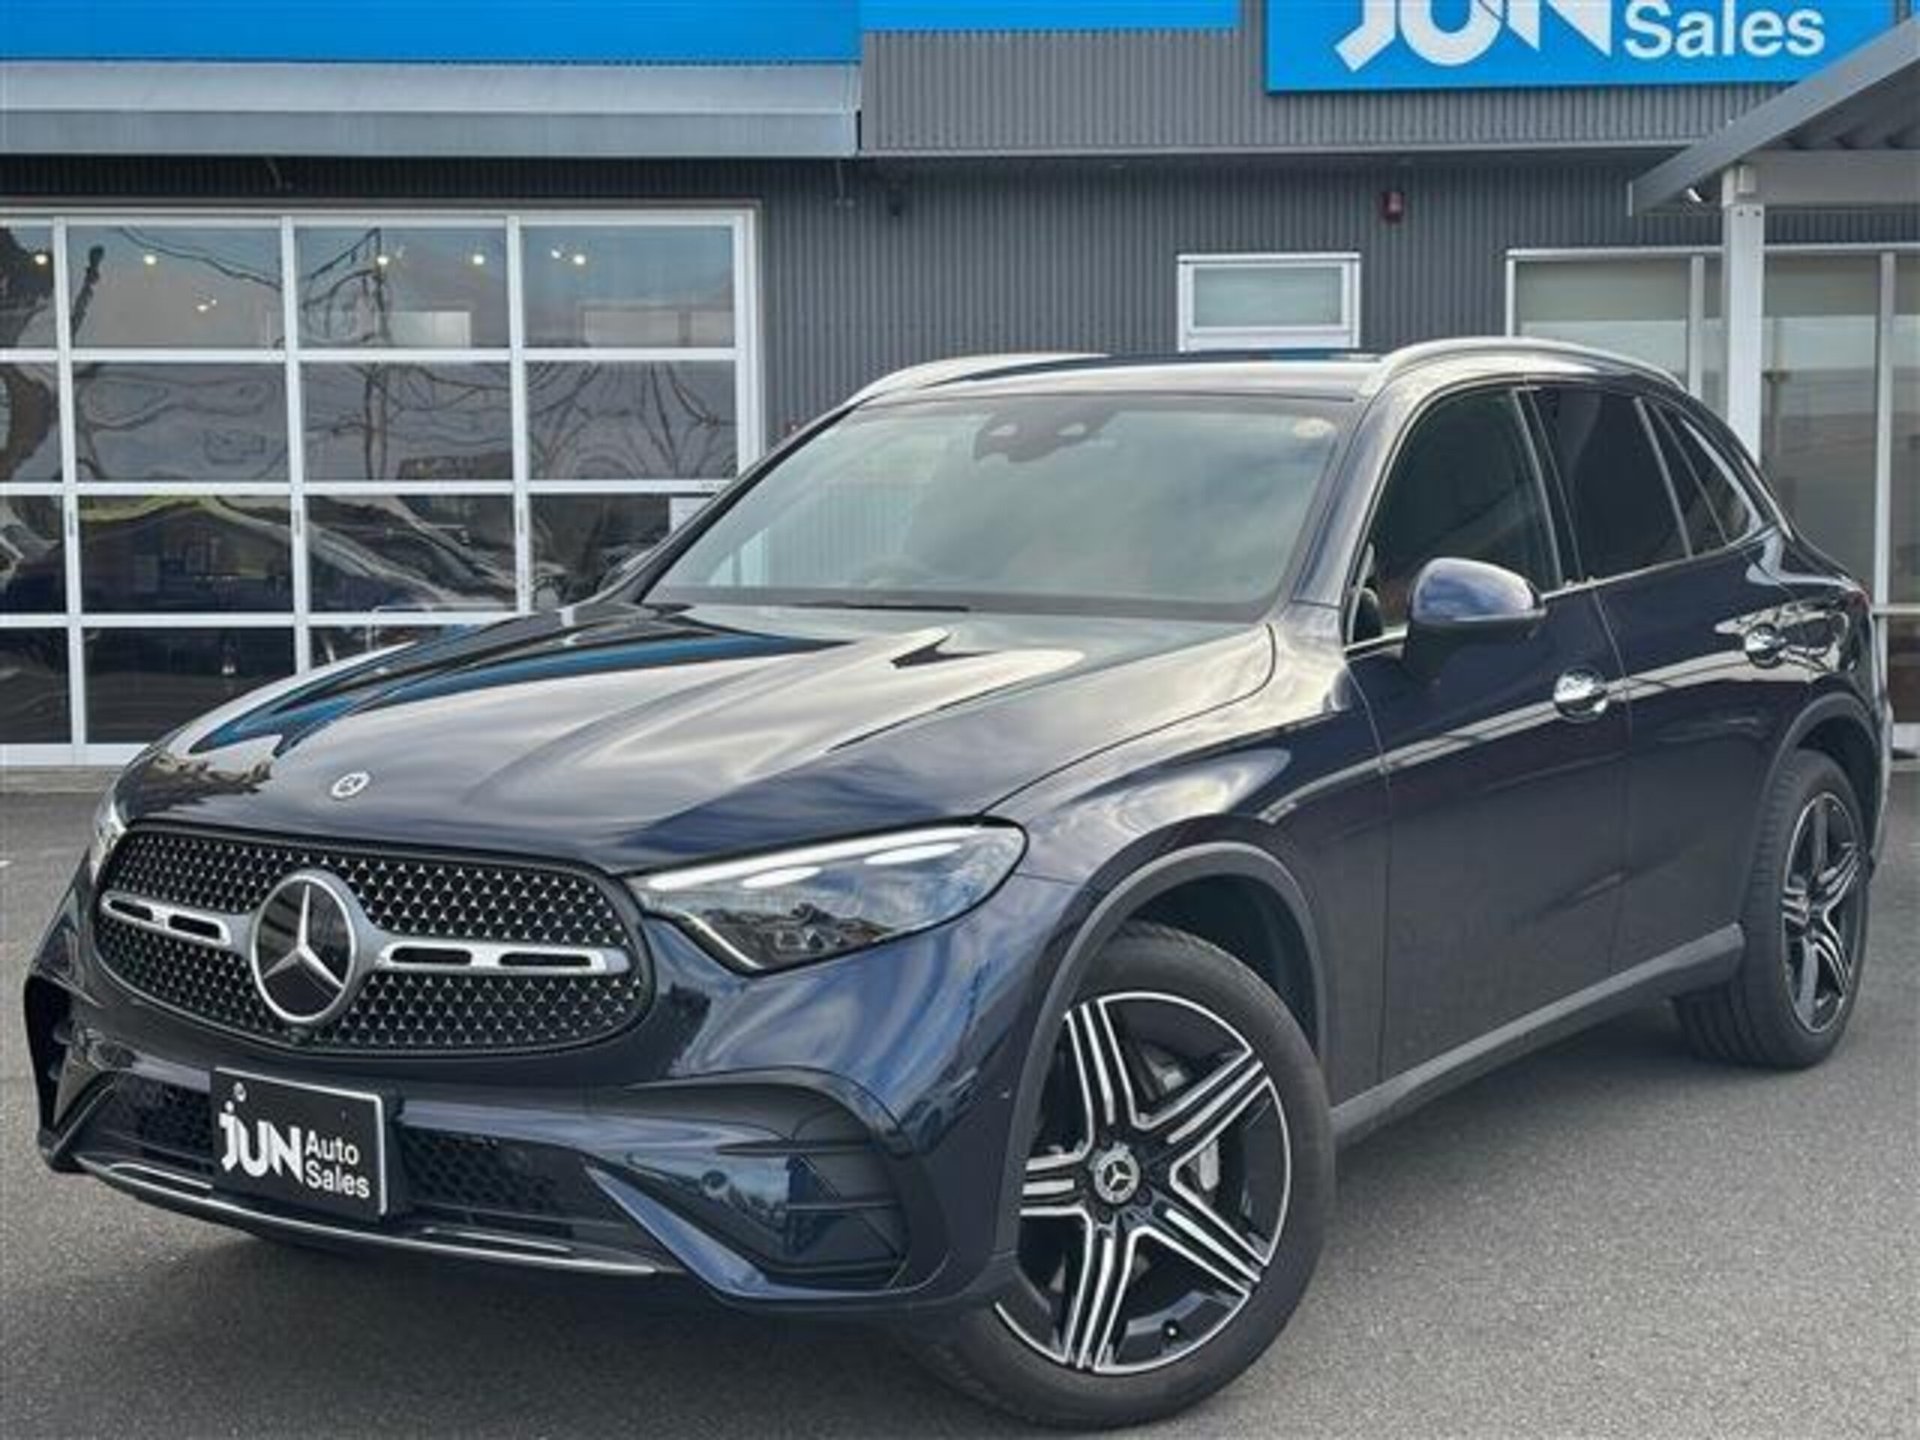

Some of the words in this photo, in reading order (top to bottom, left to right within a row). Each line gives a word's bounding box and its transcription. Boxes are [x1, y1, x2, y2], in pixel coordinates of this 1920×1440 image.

[1623, 0, 1826, 58] Sales
[305, 1130, 360, 1165] Auto
[305, 1160, 371, 1198] Sales
